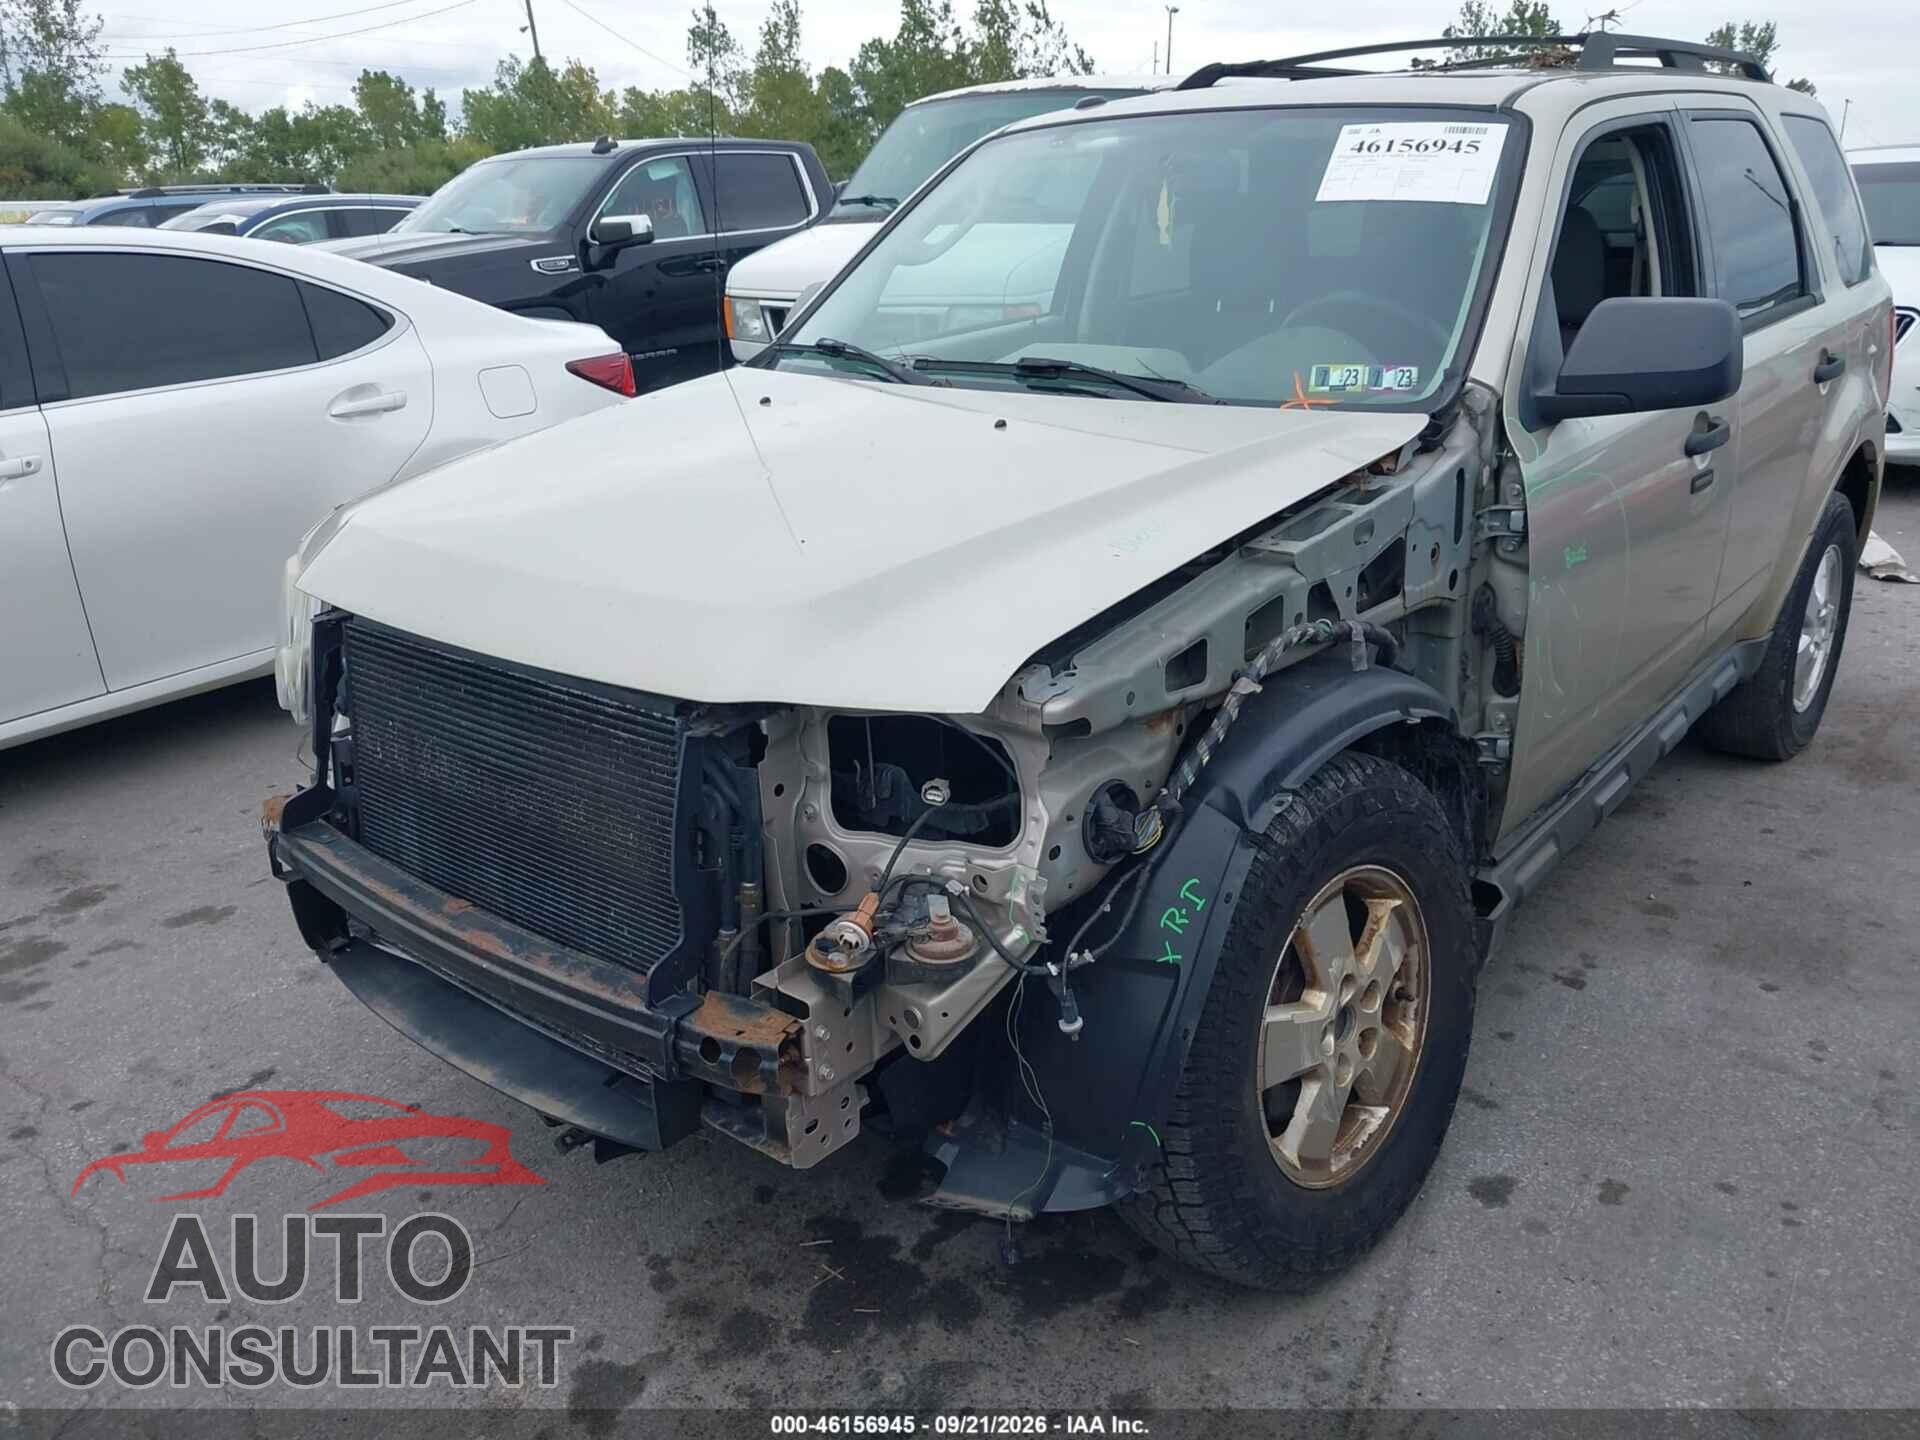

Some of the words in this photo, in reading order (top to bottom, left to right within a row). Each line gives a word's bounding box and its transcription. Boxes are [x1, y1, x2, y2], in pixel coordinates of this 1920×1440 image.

[1350, 138, 1481, 154] 46156945
[1343, 368, 1360, 387] 23
[1397, 368, 1413, 388] 23
